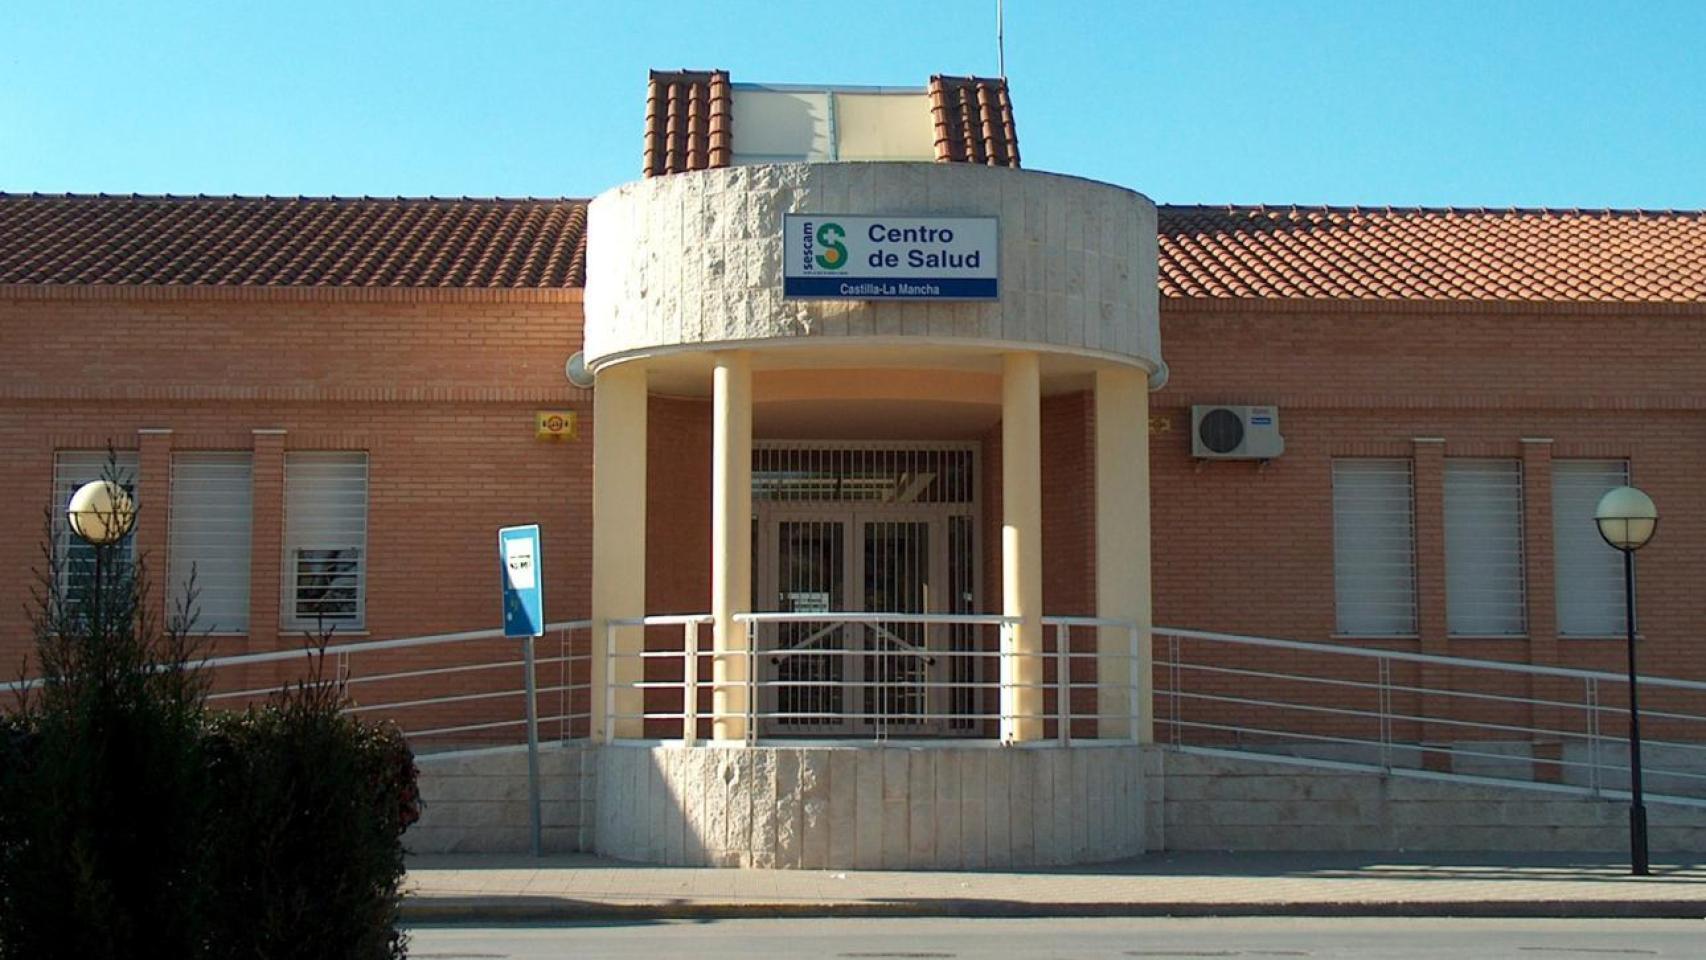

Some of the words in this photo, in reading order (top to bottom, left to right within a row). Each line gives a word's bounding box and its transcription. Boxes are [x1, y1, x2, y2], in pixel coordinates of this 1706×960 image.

[868, 224, 953, 243] Centro
[803, 222, 813, 270] sescam
[868, 250, 899, 268] de
[908, 249, 980, 268] Salud
[840, 283, 896, 295] Castilla-La
[899, 283, 940, 295] Mancha
